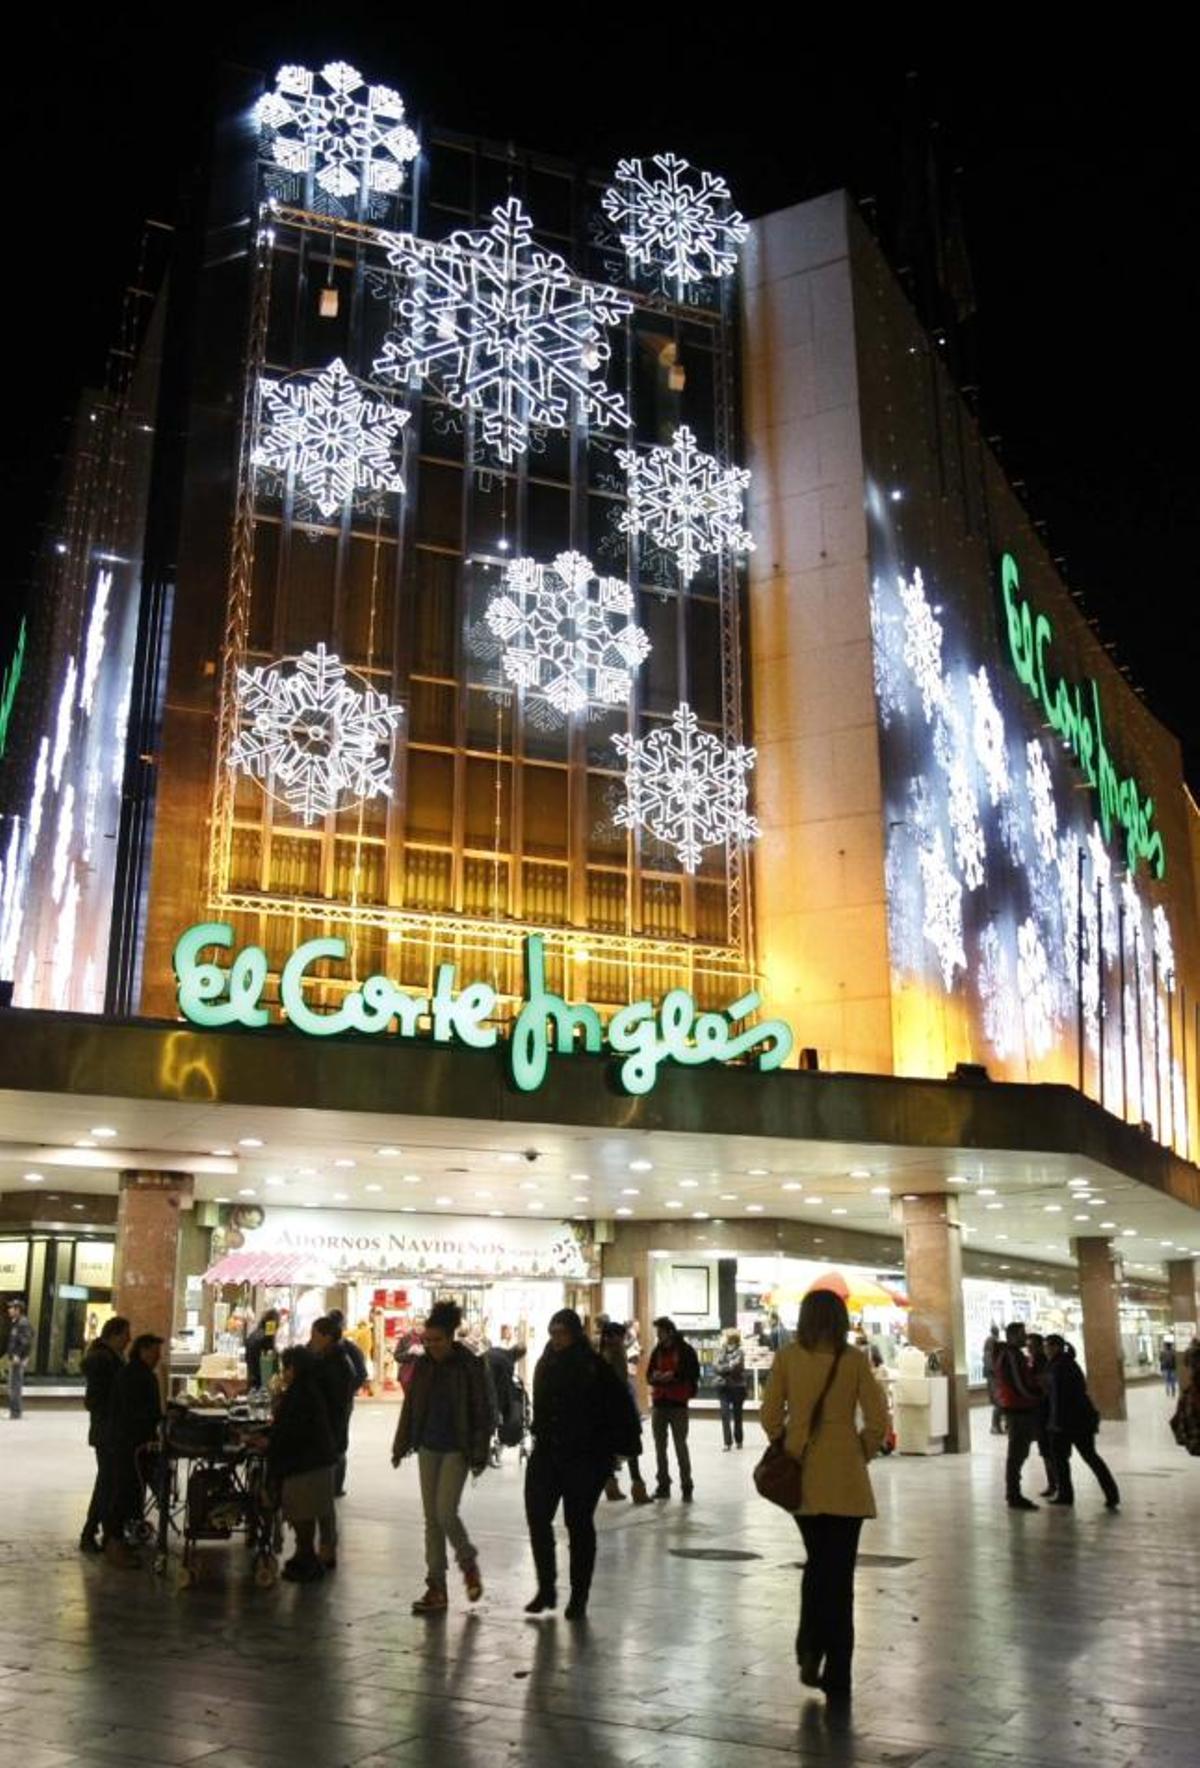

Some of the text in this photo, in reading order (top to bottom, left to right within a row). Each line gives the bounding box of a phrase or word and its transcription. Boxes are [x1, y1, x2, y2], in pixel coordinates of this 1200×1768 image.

[174, 920, 793, 1095] El Corte Inglés
